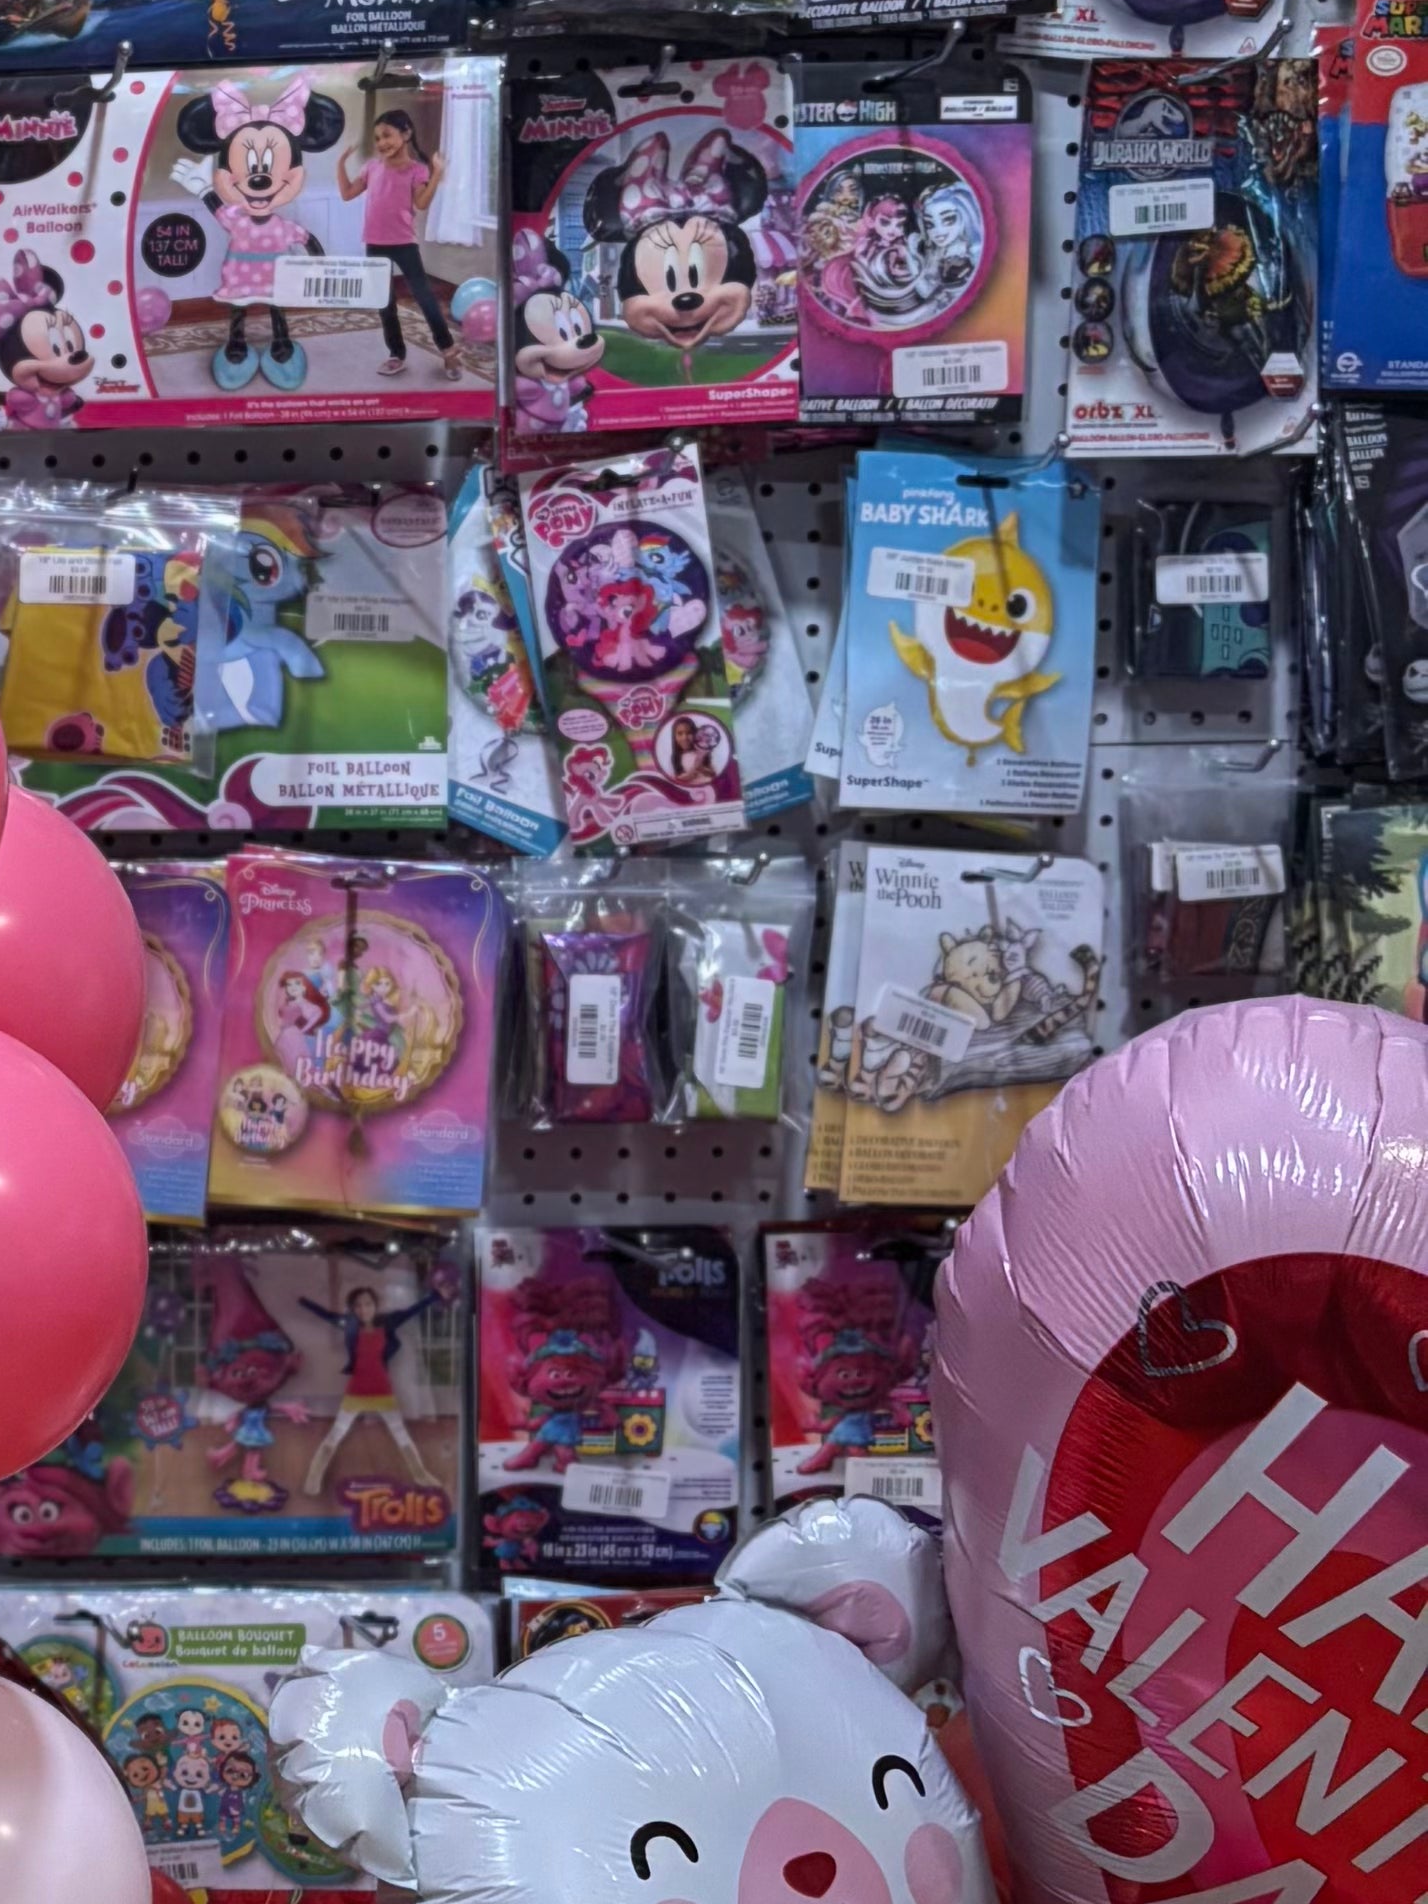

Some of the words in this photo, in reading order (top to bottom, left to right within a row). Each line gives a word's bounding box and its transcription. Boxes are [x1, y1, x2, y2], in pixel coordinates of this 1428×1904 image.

[346, 12, 366, 22] FOIL
[368, 10, 412, 22] BALLOON
[1075, 8, 1095, 22] XL
[331, 24, 366, 34] BALLON
[368, 19, 426, 32] MÉTALLIQUE
[1363, 14, 1428, 38] MARI
[859, 101, 896, 121] HIGH
[518, 110, 613, 143] MINNIE
[1092, 140, 1157, 165] JURASSIC
[1158, 140, 1212, 165] WORLD
[13, 202, 91, 217] AirWalkers
[26, 221, 83, 234] Balloon
[175, 225, 191, 236] IN
[149, 239, 169, 251] 137
[173, 239, 199, 251] CM
[708, 388, 789, 401] SuperShape
[837, 397, 879, 411] BALLOON
[907, 397, 942, 410] BALLON
[902, 487, 955, 505] pinkfong
[860, 502, 915, 524] BABY
[918, 504, 990, 528] SHARK
[532, 503, 599, 548] PONY
[307, 761, 339, 777] FOIL
[346, 760, 412, 776] BALLOON
[279, 782, 336, 799] BALLON
[343, 777, 440, 802] MÉTALLIQUE
[846, 775, 923, 791] SuperShape
[456, 786, 480, 804] Foil
[485, 798, 540, 831] Balloon
[875, 867, 940, 890] Winnie
[260, 882, 296, 896] Disney
[876, 887, 896, 904] the
[895, 887, 943, 910] Pooh
[239, 892, 313, 916] PRINCESS
[313, 1028, 396, 1072] Happy
[295, 1056, 410, 1097] Birthday
[350, 1486, 445, 1528] Trolls
[178, 1629, 233, 1642] BALLOON
[237, 1629, 295, 1643] BOUQUET
[433, 1622, 446, 1642] 5
[175, 1645, 228, 1659] Bouquet
[232, 1644, 250, 1657] de
